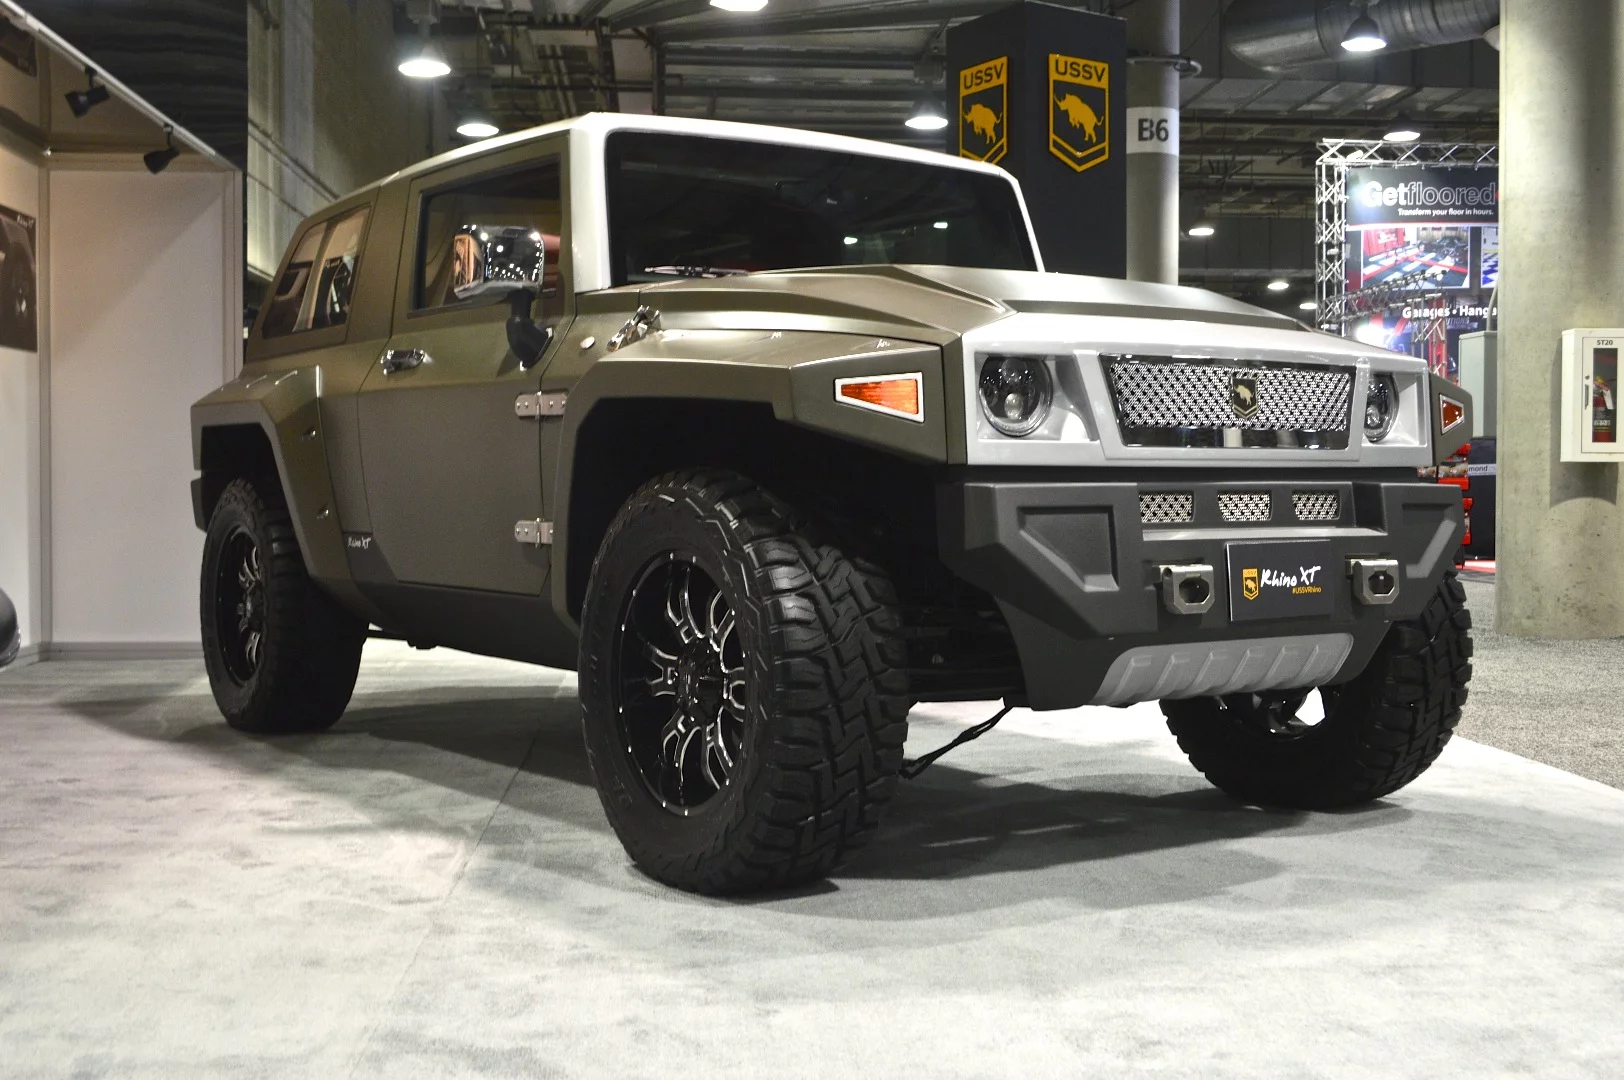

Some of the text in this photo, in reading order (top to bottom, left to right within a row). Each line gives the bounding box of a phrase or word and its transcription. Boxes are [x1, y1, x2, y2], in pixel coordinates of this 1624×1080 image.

[963, 63, 1004, 90] USSV
[1055, 58, 1105, 82] USSV
[1138, 117, 1169, 143] B6
[1363, 180, 1496, 207] Getfloored
[1398, 208, 1432, 216] Transform
[1432, 209, 1448, 217] your
[1473, 208, 1494, 216] hours.
[1260, 565, 1322, 588] Rhino XT
[1292, 586, 1322, 595] #USSVRhino
